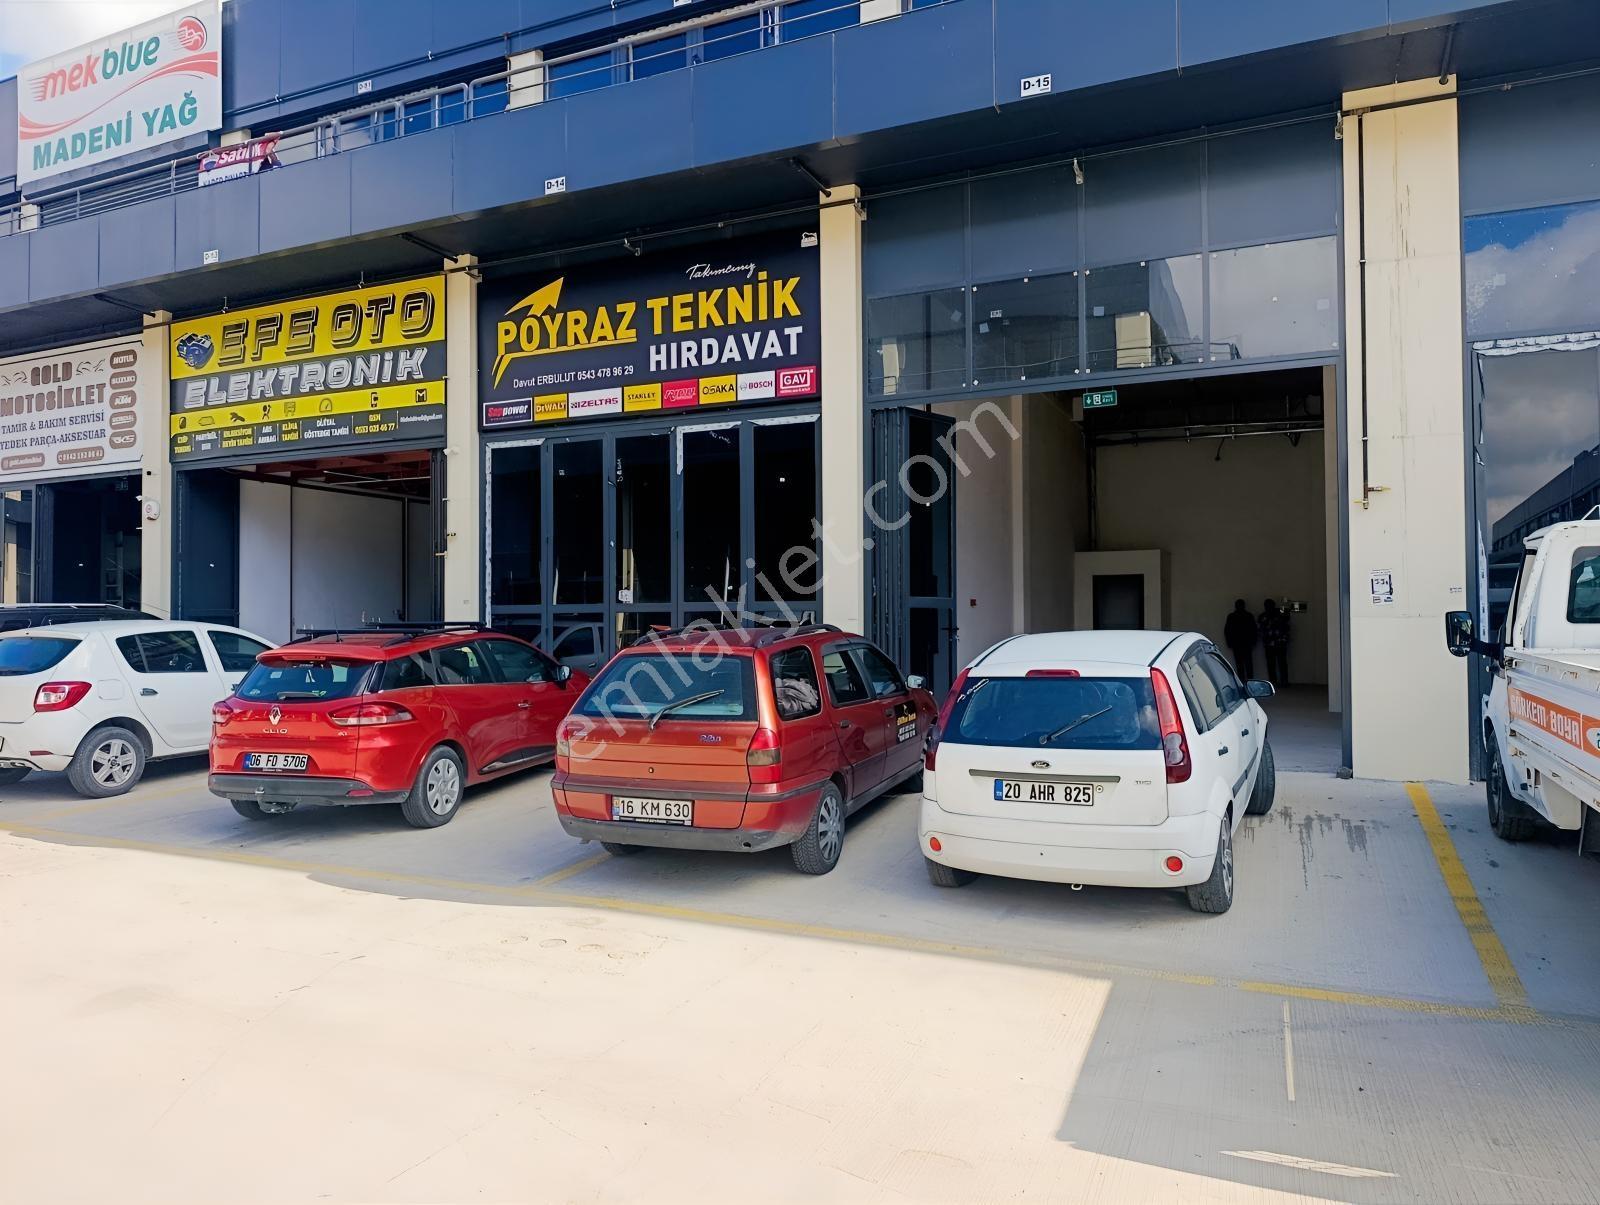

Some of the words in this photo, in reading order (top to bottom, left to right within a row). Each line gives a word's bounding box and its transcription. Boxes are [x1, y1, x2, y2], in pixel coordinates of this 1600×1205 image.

[1023, 76, 1050, 90] D-15
[33, 110, 133, 171] MADENİ
[142, 90, 198, 137] YAĞ
[546, 178, 565, 190] D-14
[498, 301, 637, 354] POYRAZ
[646, 271, 801, 335] TEKNİK
[218, 306, 320, 367] EFE
[330, 287, 435, 349] OTO
[649, 326, 803, 371] HIRDAVAT
[31, 361, 73, 387] GOLD
[184, 347, 428, 408] ELEKTRONİK
[513, 376, 536, 388] Davut
[537, 371, 576, 385] ERBULUT
[577, 368, 596, 381] 0543
[598, 368, 611, 379] 478
[612, 366, 622, 377] 96
[623, 365, 634, 375] 29
[783, 373, 807, 385] GAV
[627, 391, 656, 400] STANLEY
[702, 383, 735, 395] OSAKA
[748, 380, 773, 390] BOSCH
[0, 382, 107, 417] MOTOSİKLET
[30, 421, 37, 431] &
[38, 416, 67, 430] BAKIM
[69, 409, 105, 426] SERVİSİ
[0, 437, 28, 450] YEDEK
[1550, 709, 1580, 746] BOYA
[250, 754, 261, 766] 06
[283, 755, 307, 768] 5706
[1004, 783, 1021, 799] 20
[1029, 784, 1055, 801] AHR
[1064, 786, 1091, 803] 825
[620, 800, 634, 814] 16
[640, 801, 660, 816] KM
[664, 803, 690, 818] 630
